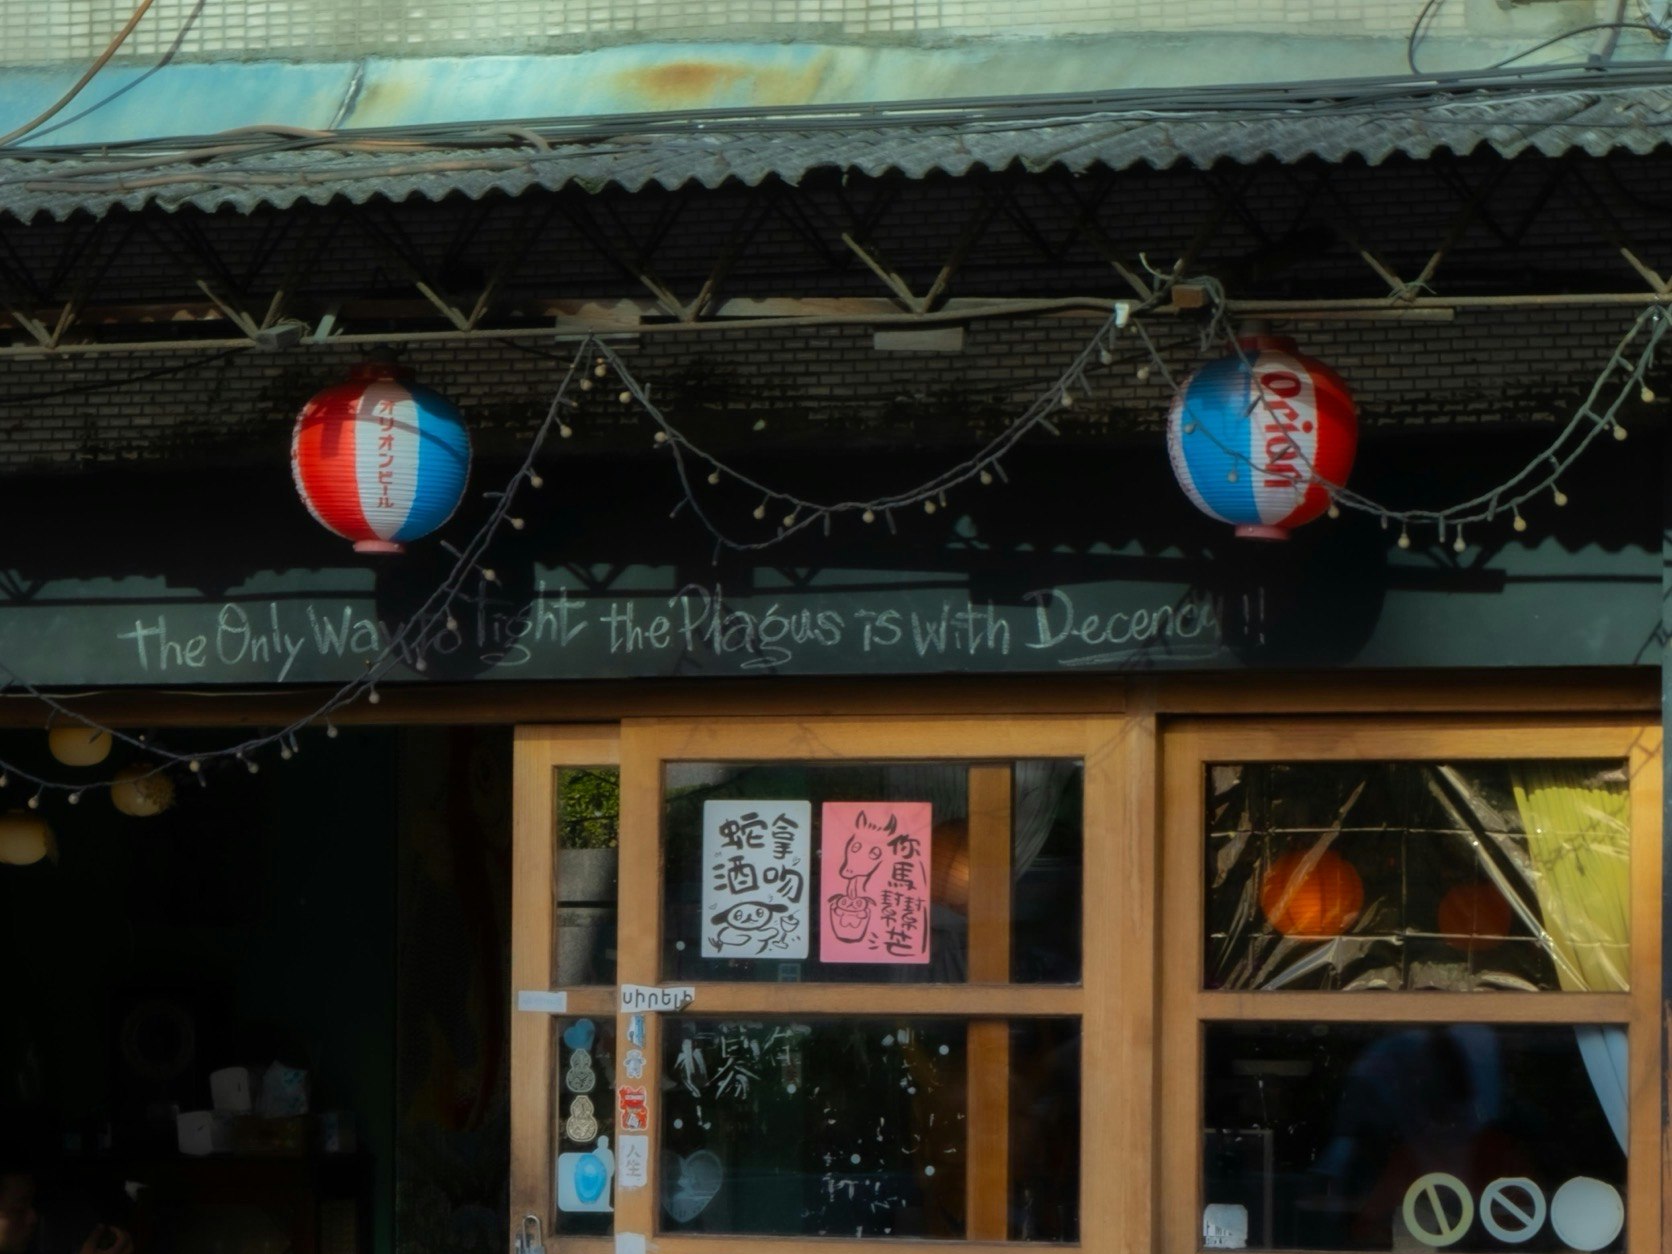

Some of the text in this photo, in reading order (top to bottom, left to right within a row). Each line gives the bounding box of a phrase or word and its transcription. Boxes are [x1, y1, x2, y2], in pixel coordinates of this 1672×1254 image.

[377, 400, 395, 509] オリオンビール
[1261, 371, 1313, 487] Orion
[216, 601, 305, 682] Only
[600, 601, 672, 654] the
